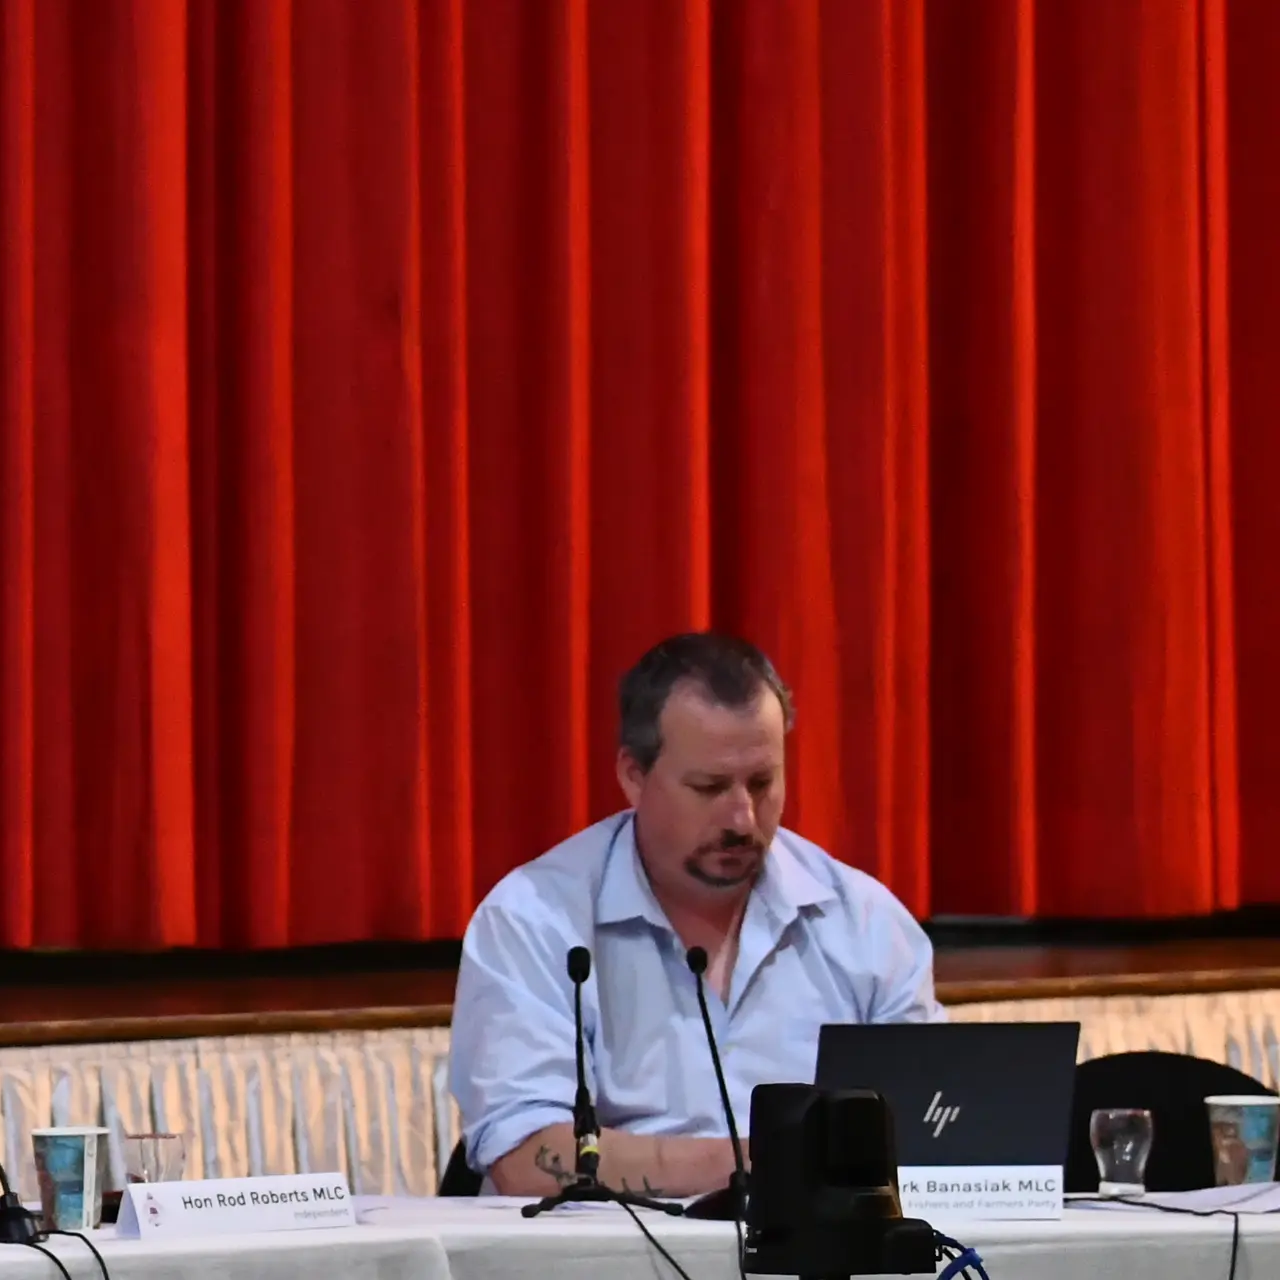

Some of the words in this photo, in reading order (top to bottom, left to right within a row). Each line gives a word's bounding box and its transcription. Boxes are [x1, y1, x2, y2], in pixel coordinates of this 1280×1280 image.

[902, 1180, 920, 1193] rk
[926, 1179, 1012, 1193] Banasiak
[1018, 1178, 1057, 1193] MLC
[181, 1195, 213, 1210] Hon
[216, 1192, 247, 1208] Rod
[250, 1189, 310, 1206] Roberts
[312, 1185, 346, 1201] MLC
[952, 1199, 974, 1210] and
